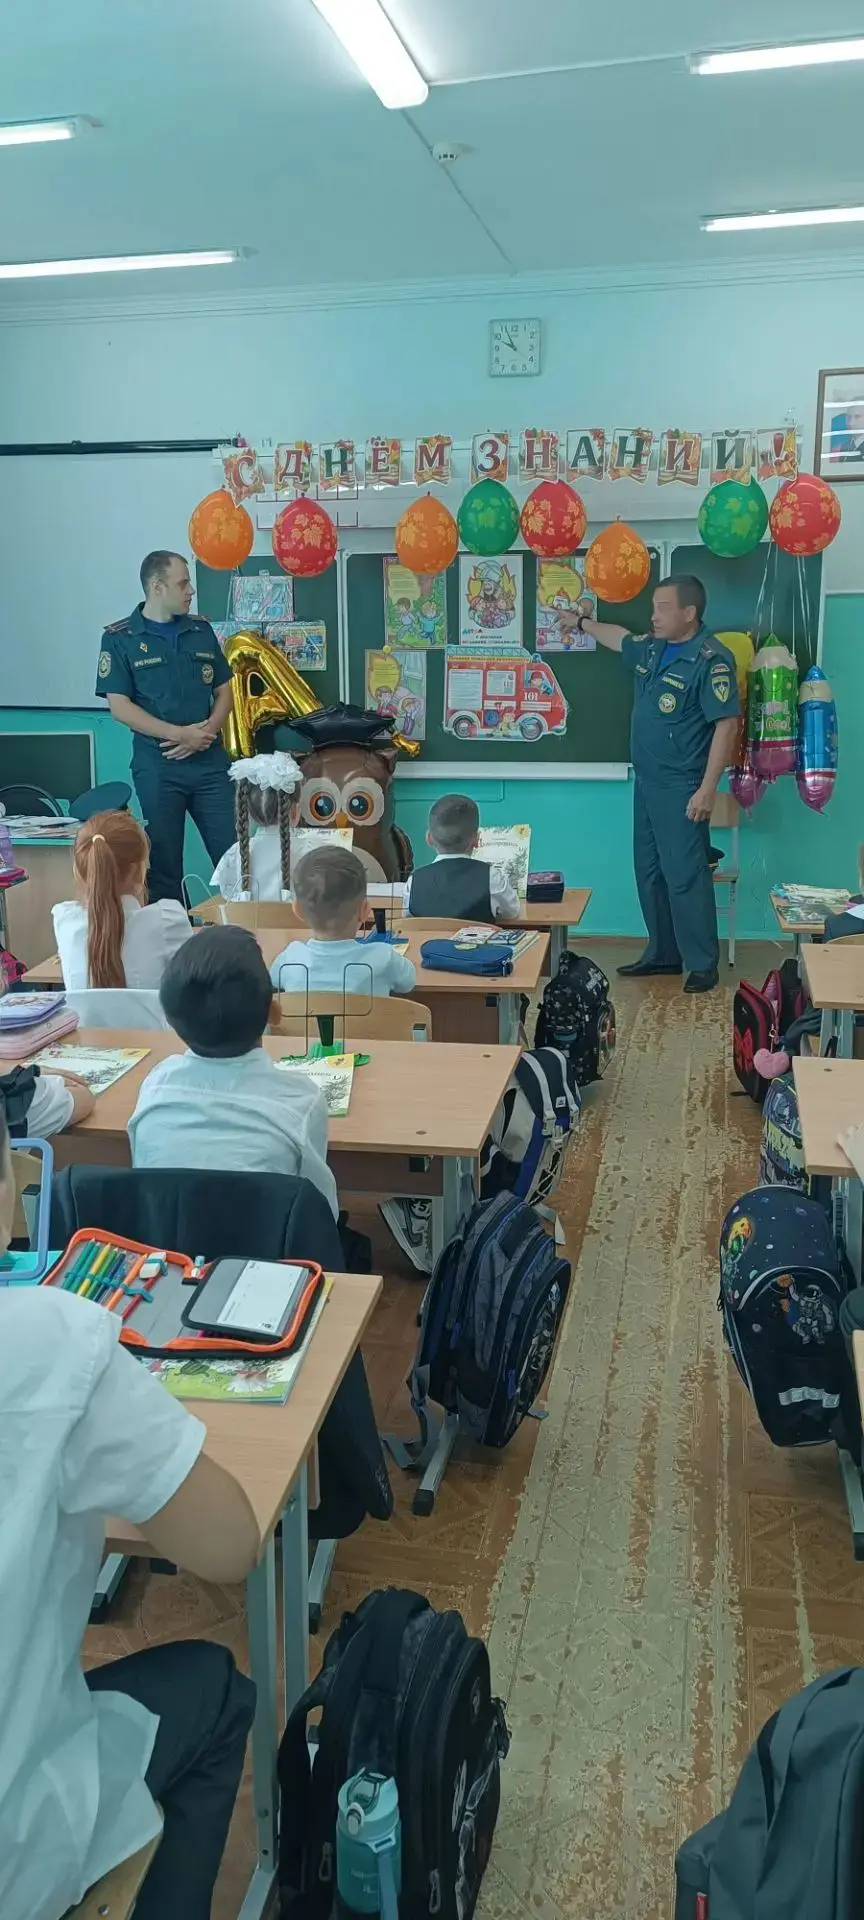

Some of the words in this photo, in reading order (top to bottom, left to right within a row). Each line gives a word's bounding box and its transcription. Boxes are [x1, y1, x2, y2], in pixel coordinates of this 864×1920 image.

[236, 456, 255, 487] С
[279, 441, 446, 483] ДНЁМ
[478, 429, 786, 473] ЗНАНИЙ!
[524, 692, 538, 702] 101
